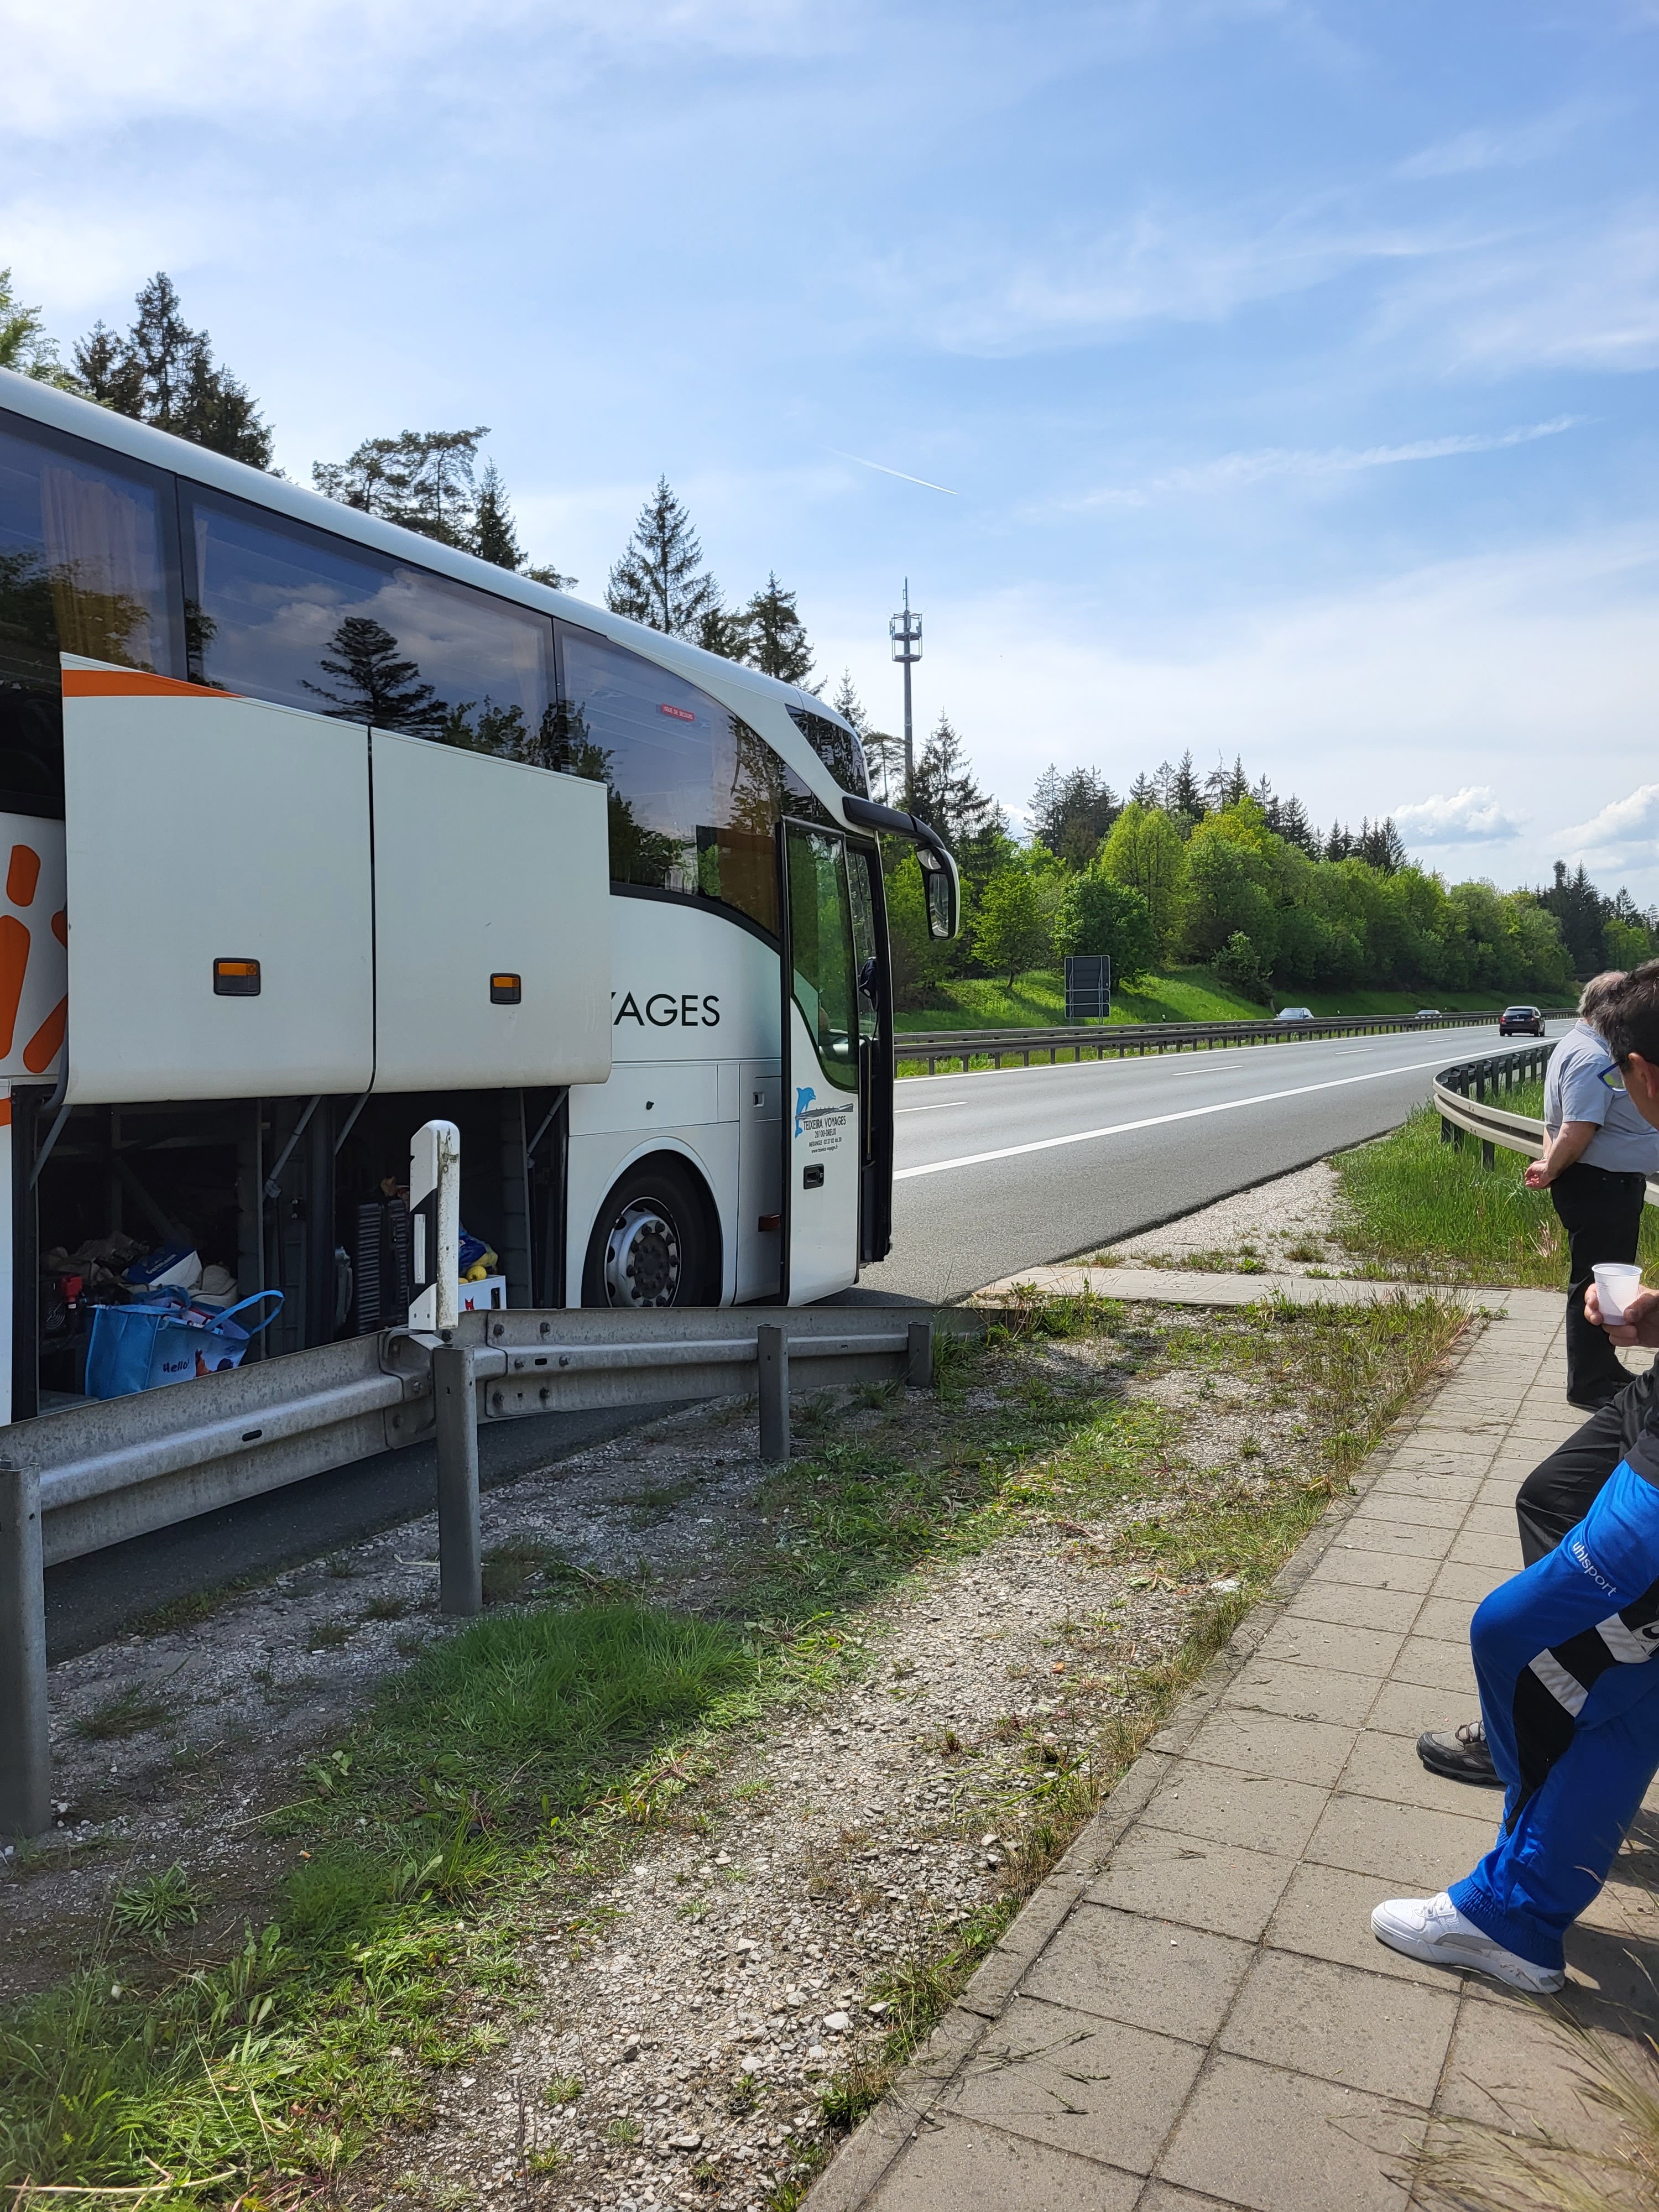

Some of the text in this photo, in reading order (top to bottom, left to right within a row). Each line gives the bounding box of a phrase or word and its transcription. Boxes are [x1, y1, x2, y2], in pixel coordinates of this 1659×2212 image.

[611, 990, 720, 1027] AGES
[804, 1115, 846, 1131] TEIXEIRA VOYAGES
[1573, 1541, 1616, 1598] uhlsport
